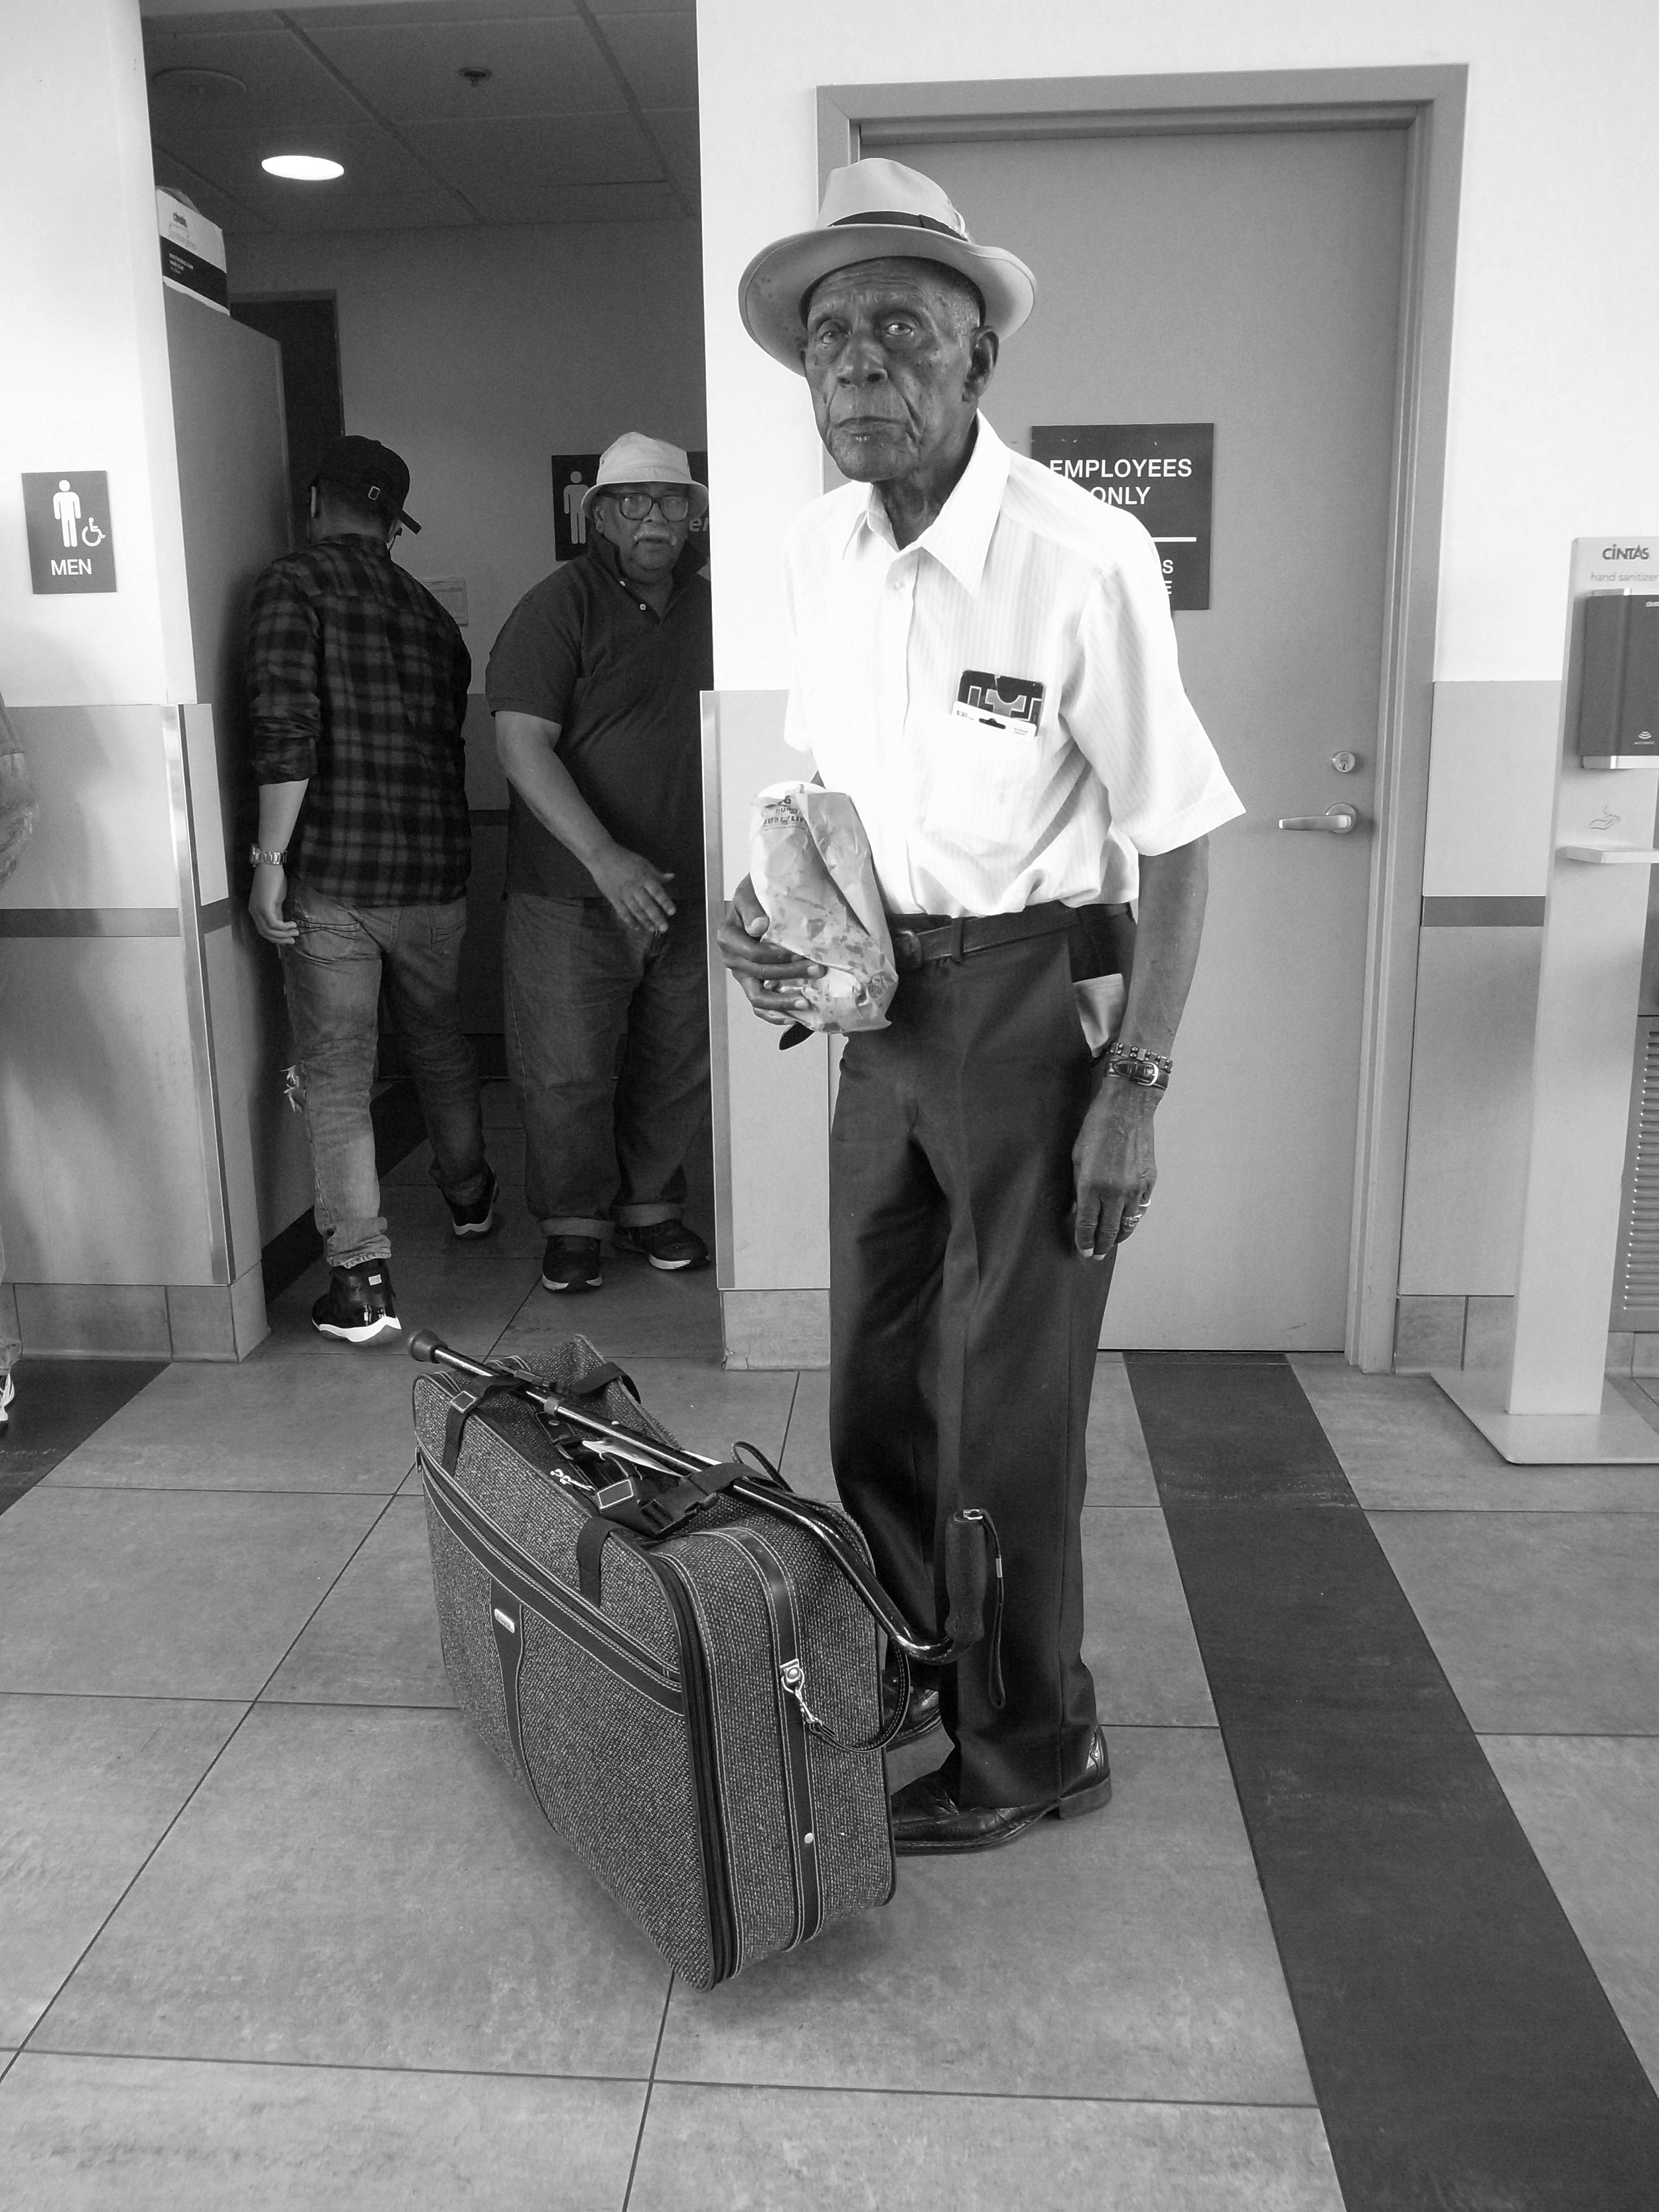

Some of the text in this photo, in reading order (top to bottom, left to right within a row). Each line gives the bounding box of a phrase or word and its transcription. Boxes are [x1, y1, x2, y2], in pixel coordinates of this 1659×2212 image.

[1050, 459, 1192, 477] EMPLOYEES
[1091, 486, 1151, 505] ONLY
[50, 559, 92, 575] MEN
[1591, 571, 1615, 581] hand
